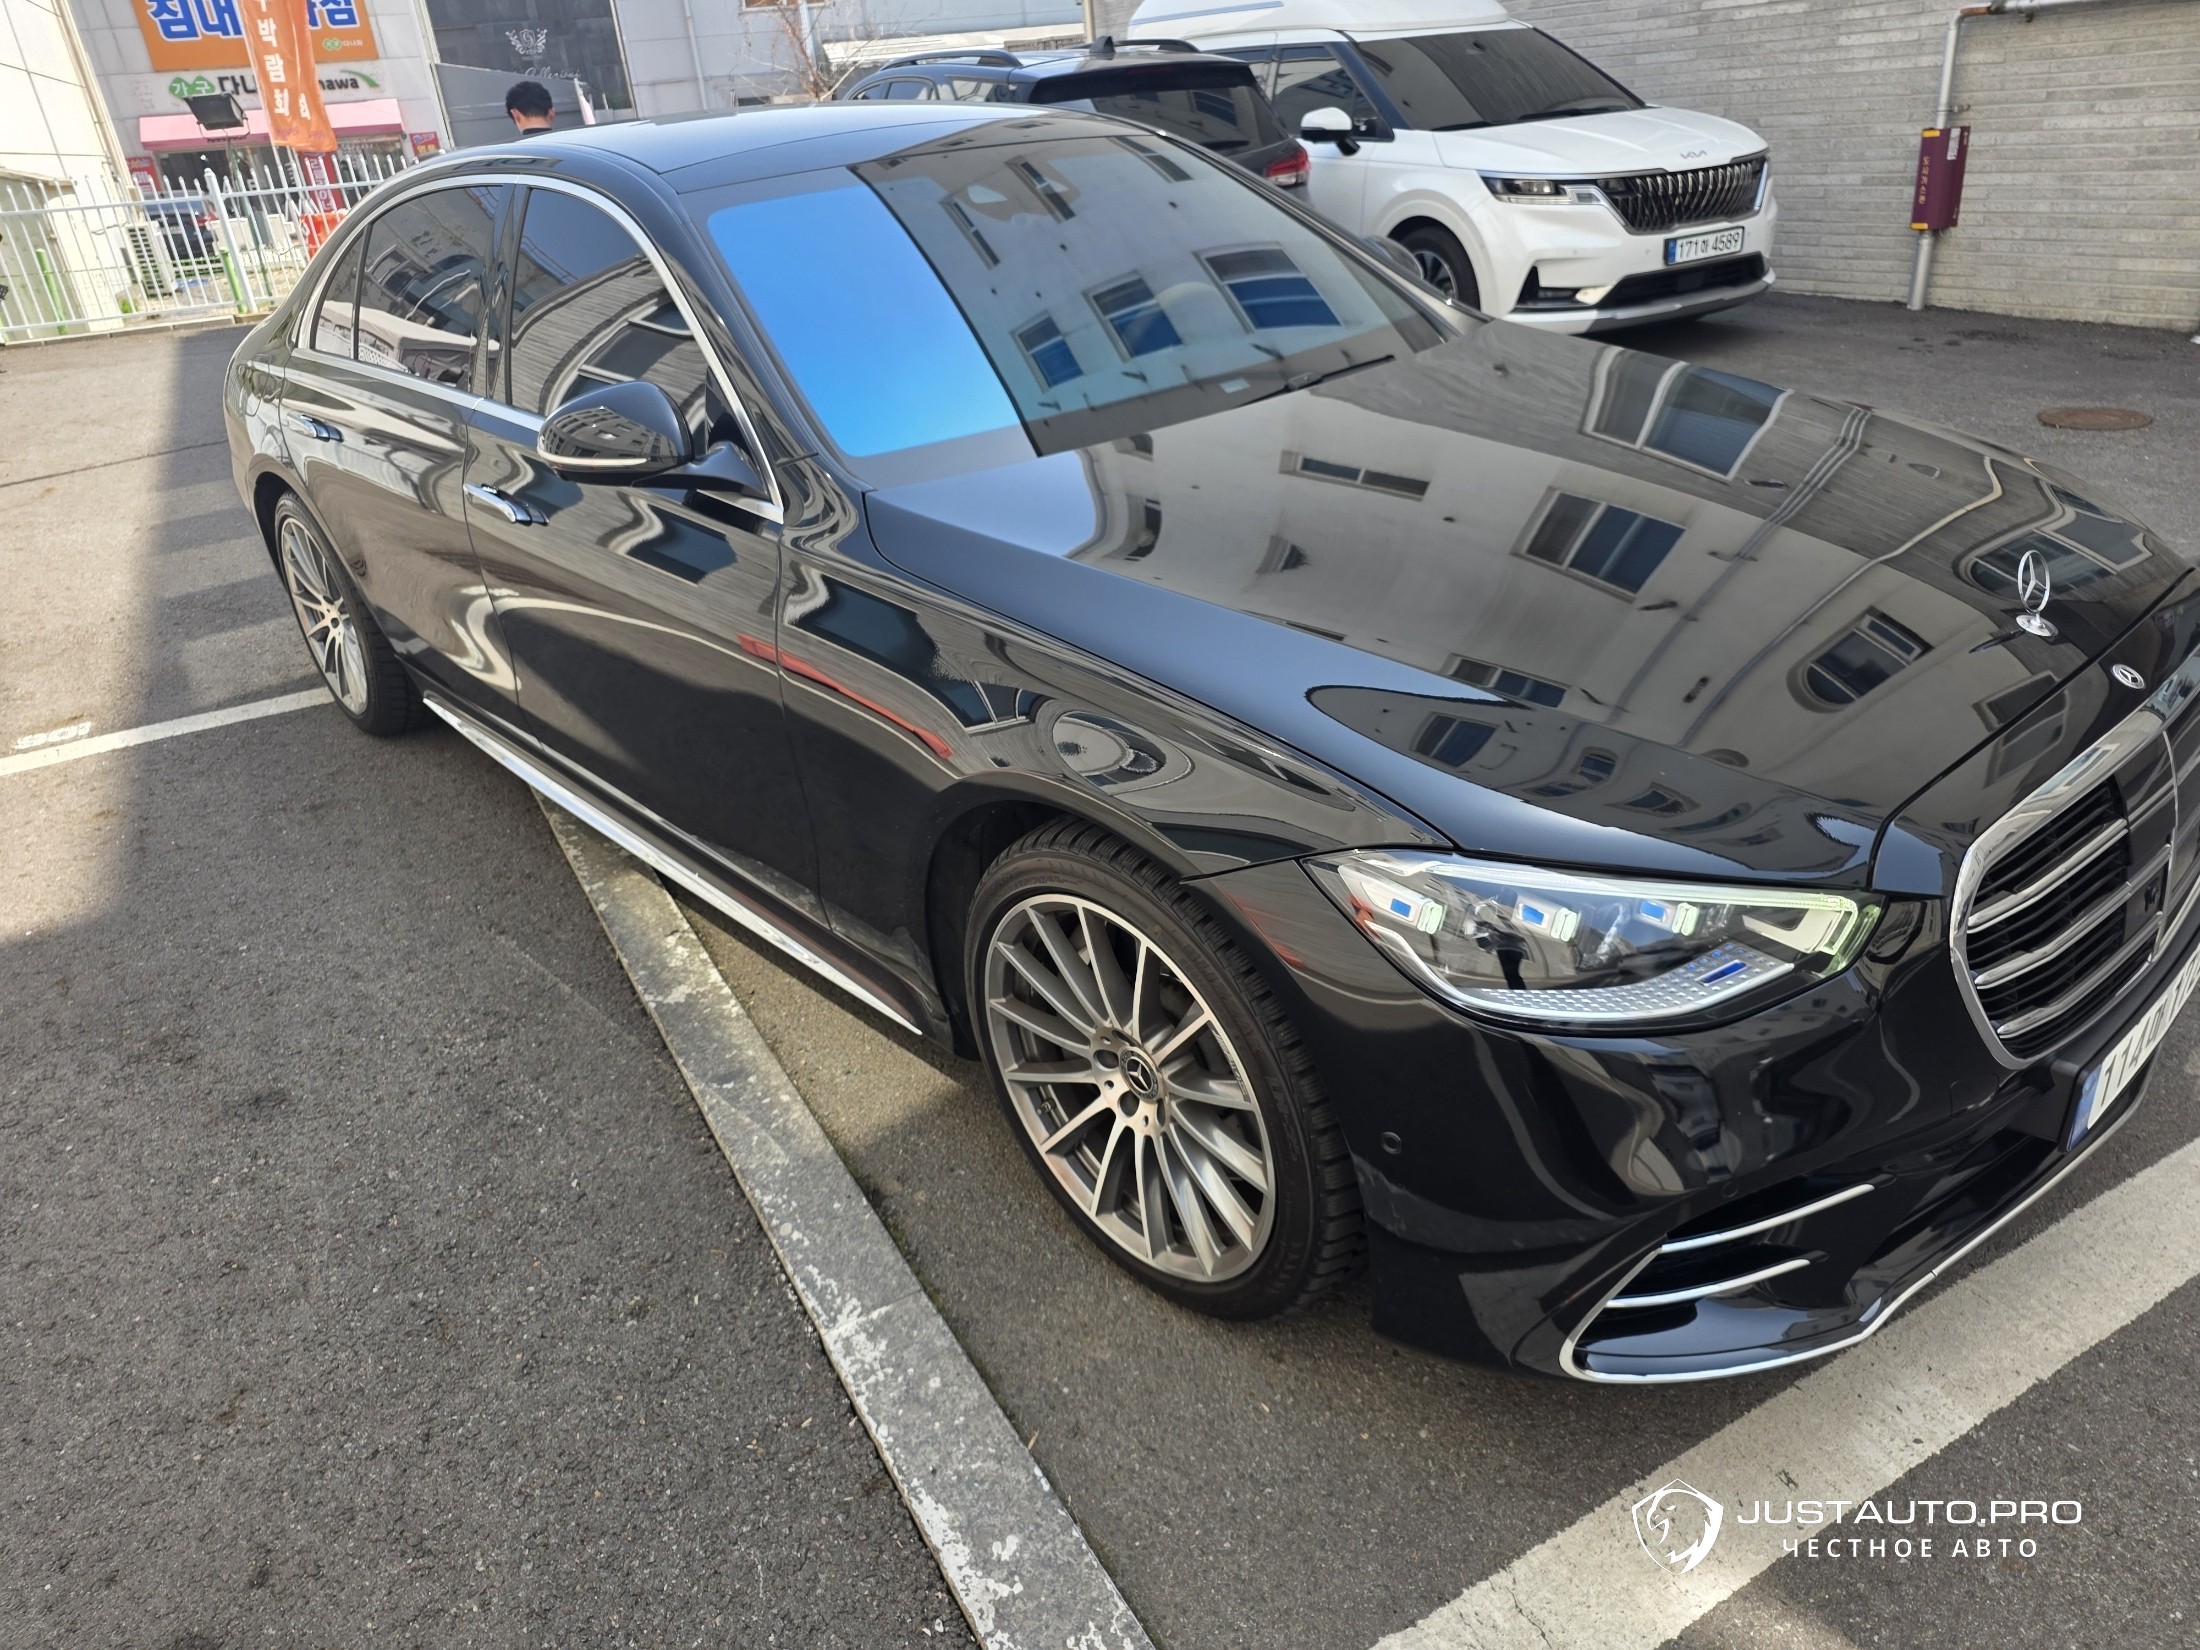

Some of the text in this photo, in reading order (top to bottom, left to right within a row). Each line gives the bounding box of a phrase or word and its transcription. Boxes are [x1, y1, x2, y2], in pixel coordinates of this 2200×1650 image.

[256, 0, 290, 117] 박람회
[172, 80, 211, 98] 가구
[318, 78, 360, 90] nawa
[1711, 231, 1740, 252] 4589
